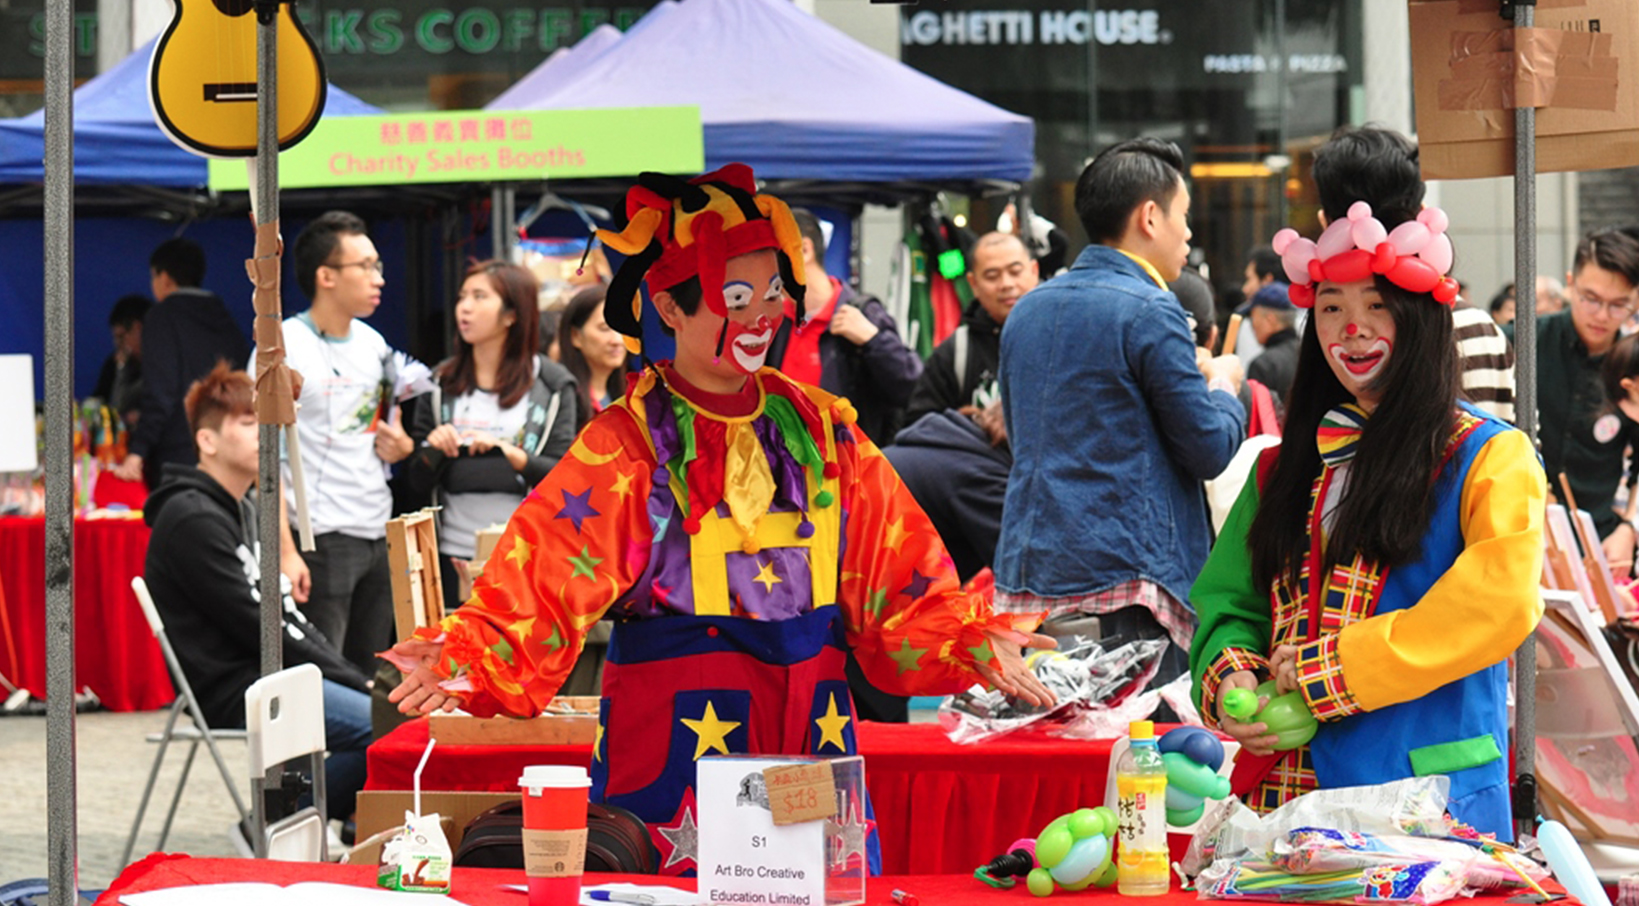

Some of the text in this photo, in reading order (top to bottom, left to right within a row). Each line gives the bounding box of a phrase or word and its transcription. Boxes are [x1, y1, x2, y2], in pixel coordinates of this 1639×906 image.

[328, 143, 586, 179] Charity Sales Booths
[783, 786, 819, 815] $18
[751, 835, 767, 848] S1
[714, 864, 805, 880] Art Bro Creative
[710, 889, 811, 906] Education Limited
